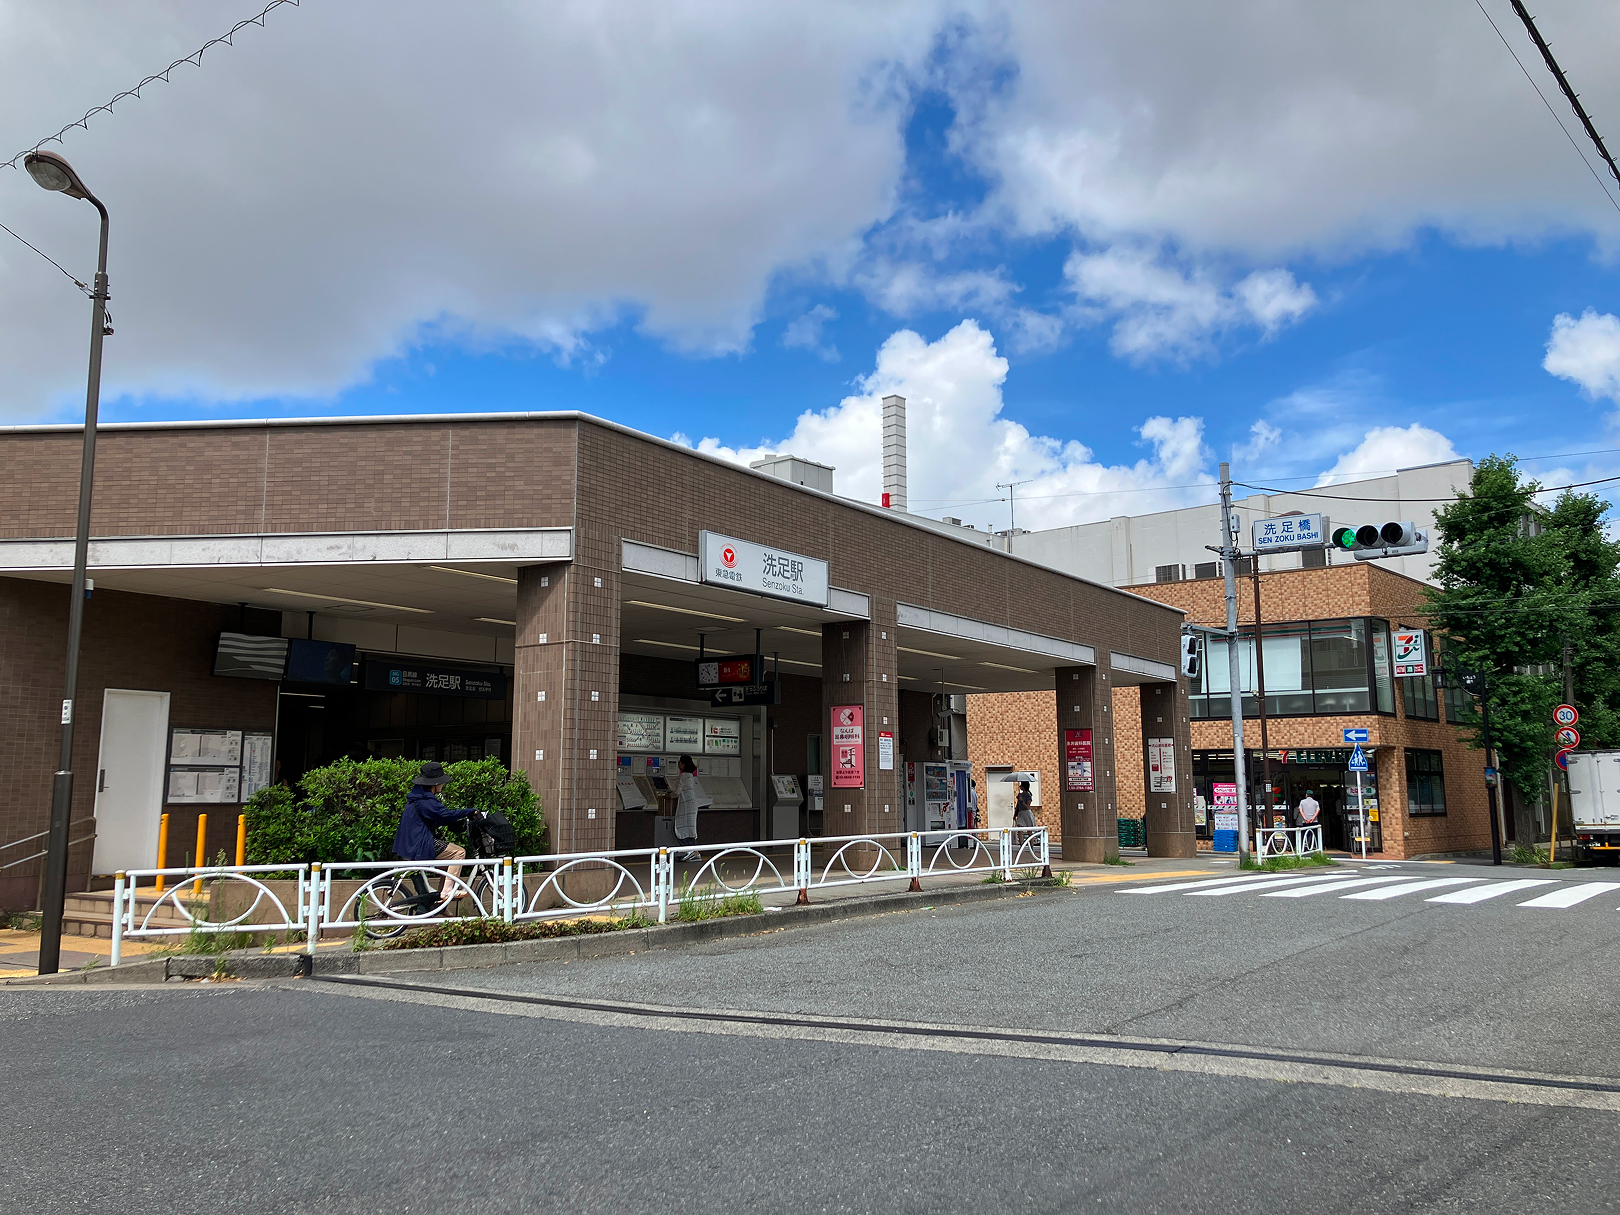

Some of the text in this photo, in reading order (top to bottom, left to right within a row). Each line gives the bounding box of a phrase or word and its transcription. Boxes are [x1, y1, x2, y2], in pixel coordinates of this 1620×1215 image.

[1264, 518, 1311, 536] 洗足橋
[1258, 531, 1319, 545] SEN ZOKU BASHI
[715, 567, 743, 582] 東急電鉄
[762, 552, 804, 583] 洗足駅
[762, 577, 804, 595] Senzoku Sta.
[402, 670, 418, 678] 目黒線
[425, 672, 461, 690] 洗足駅
[465, 679, 483, 687] Senzoku
[1558, 710, 1573, 721] 30
